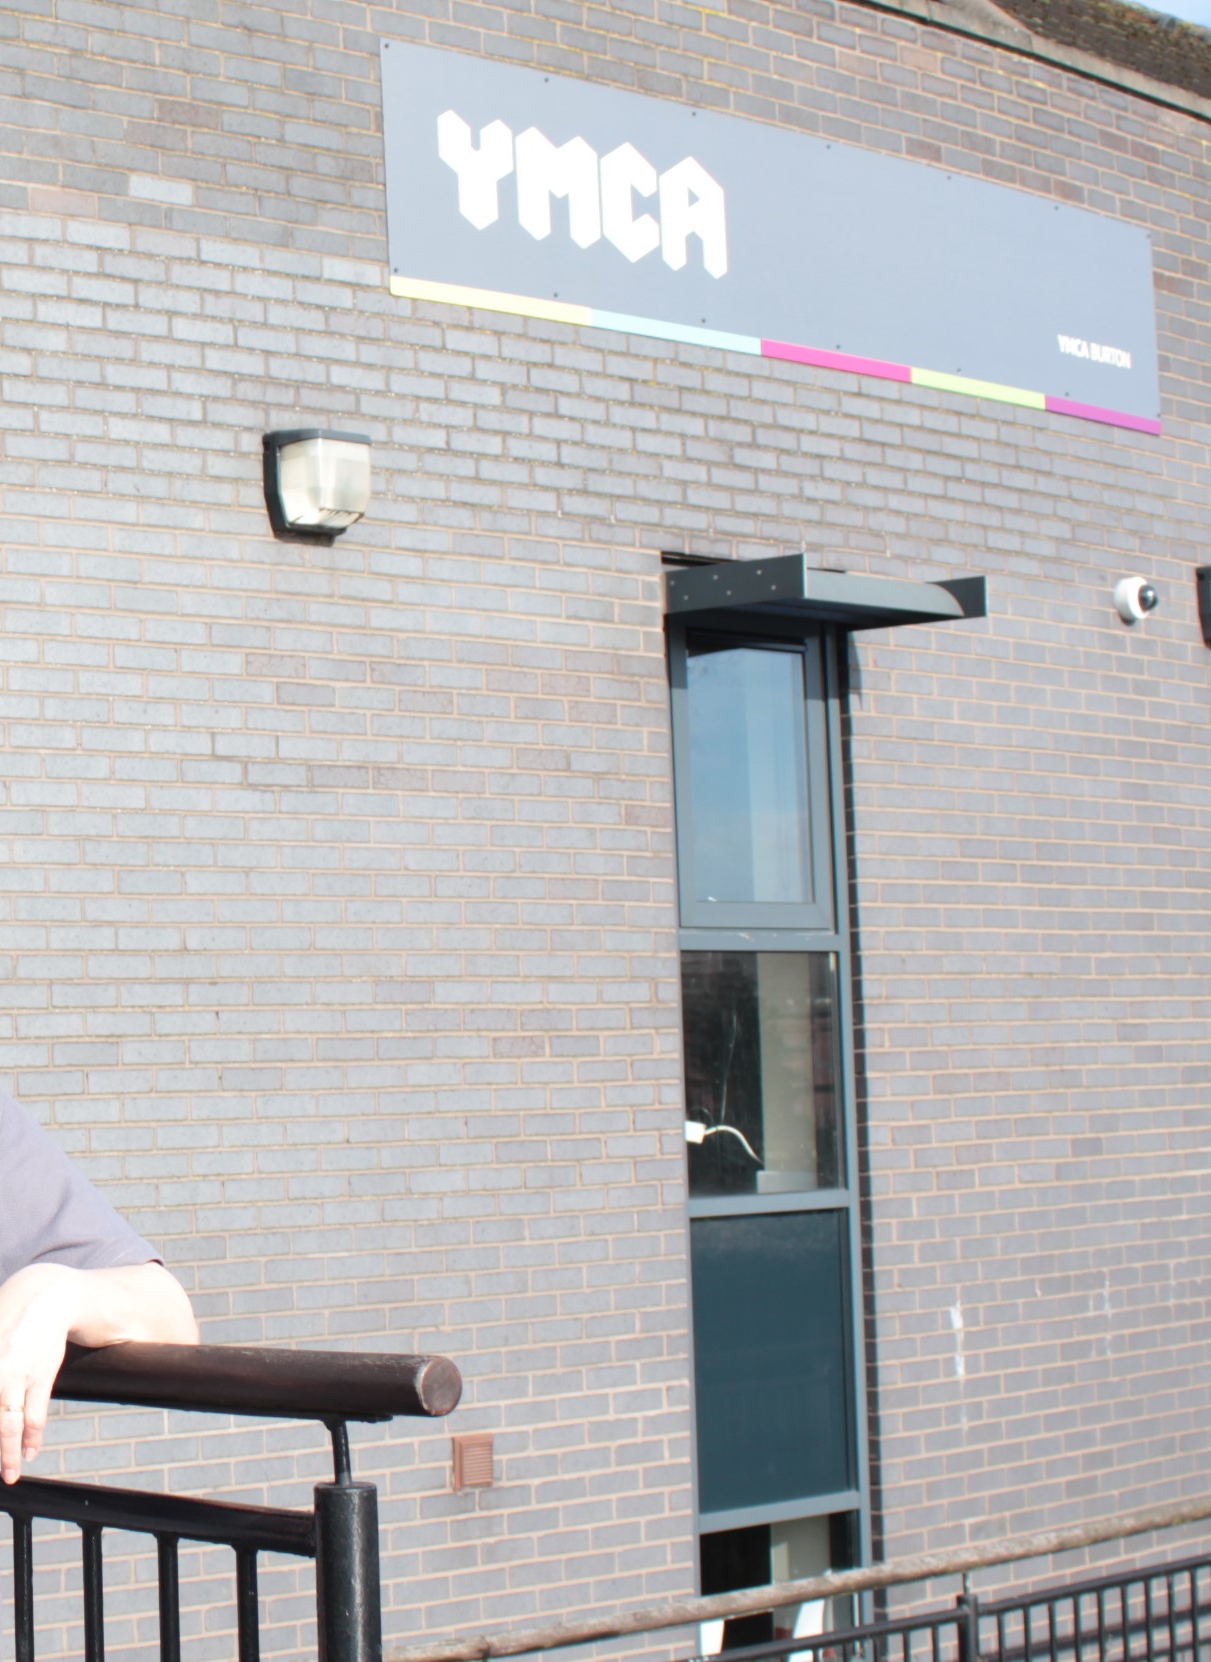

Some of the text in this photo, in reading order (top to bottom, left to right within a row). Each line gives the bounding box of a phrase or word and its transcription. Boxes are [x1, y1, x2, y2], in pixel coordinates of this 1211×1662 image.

[437, 109, 728, 280] YMCA
[1057, 334, 1131, 369] YMCA BURTON
